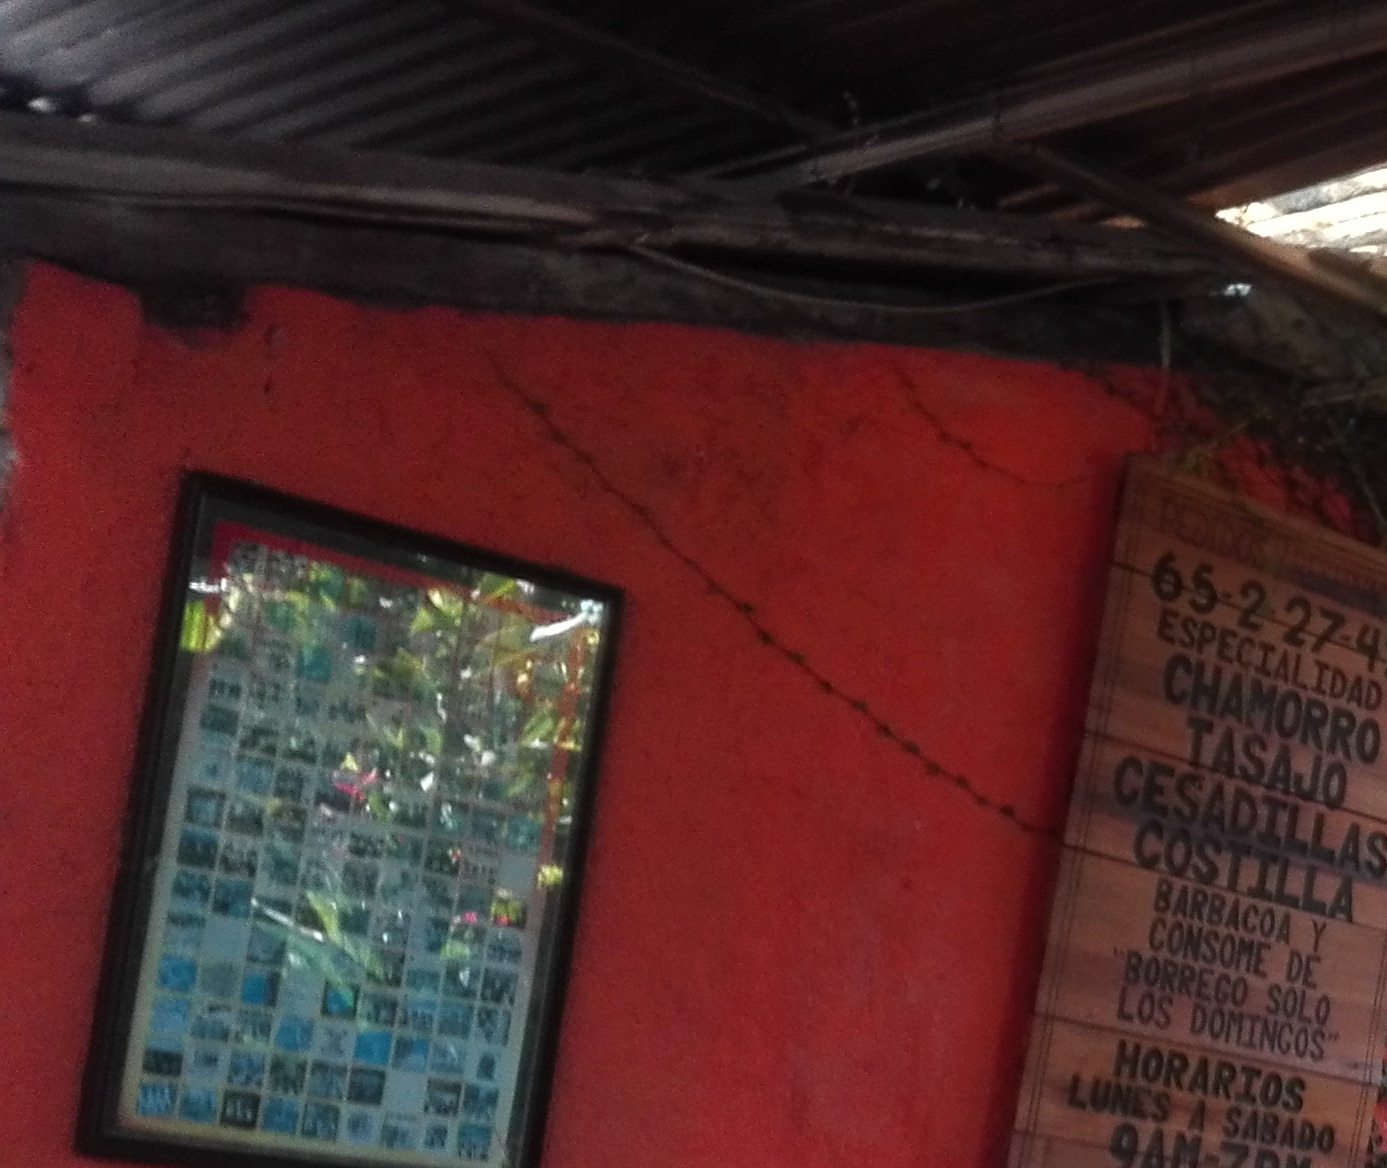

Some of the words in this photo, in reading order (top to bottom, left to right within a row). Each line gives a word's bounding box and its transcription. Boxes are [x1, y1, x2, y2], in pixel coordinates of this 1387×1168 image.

[1162, 655, 1381, 765] CHAMORRO
[1187, 715, 1346, 808] TASAJO
[1134, 818, 1354, 923] COSTILLA
[1153, 878, 1292, 945] BARBACOA
[1311, 919, 1327, 952] Y
[1147, 918, 1271, 979] CONSOME
[1287, 953, 1321, 990] DE
[1116, 986, 1172, 1029] LOS
[1267, 985, 1331, 1026] SOLO
[1113, 1040, 1307, 1113] HORARIOS
[1066, 1074, 1171, 1124] LUNES
[1188, 1099, 1205, 1133] A
[1221, 1106, 1335, 1156] SABADO
